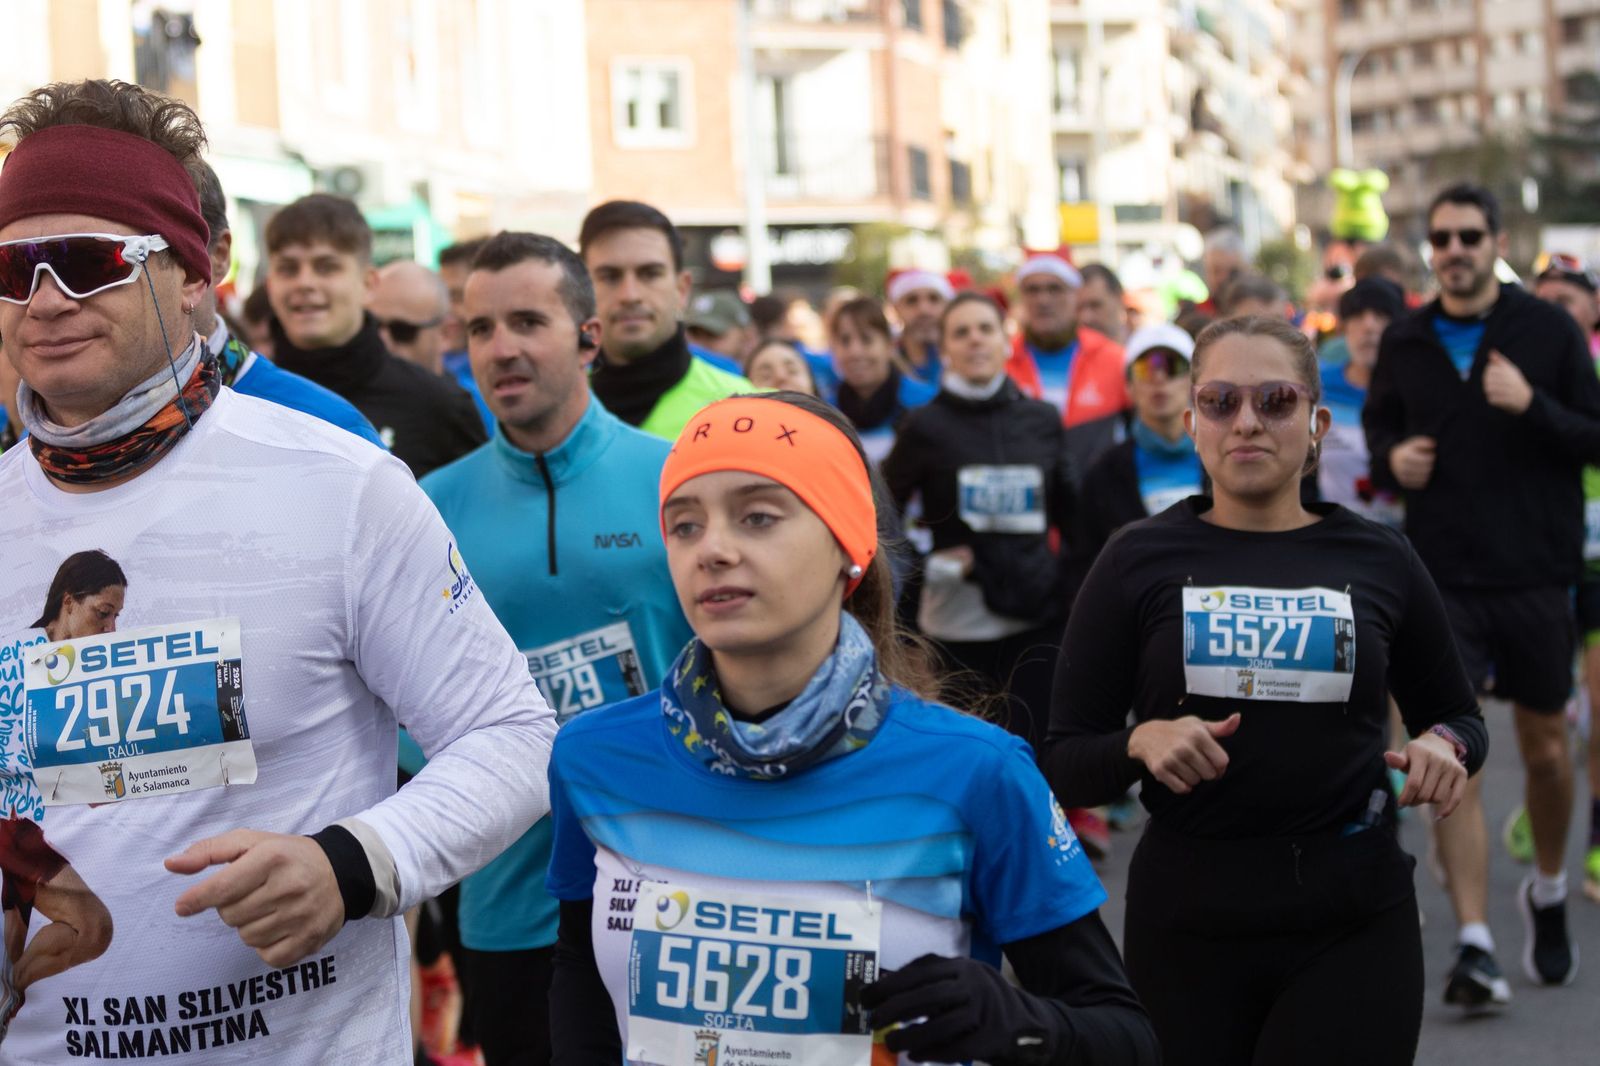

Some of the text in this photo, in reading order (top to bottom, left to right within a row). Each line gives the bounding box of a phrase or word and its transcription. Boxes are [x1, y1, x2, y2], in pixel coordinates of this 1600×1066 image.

[594, 533, 642, 548] NASA
[1230, 594, 1336, 612] SETEL
[81, 630, 219, 673] SETEL
[1209, 613, 1313, 661] 5527
[529, 636, 617, 674] SETEL
[1247, 658, 1274, 670] JOHA
[233, 667, 241, 690] 2924
[55, 669, 191, 752] 2924
[107, 741, 144, 759] RAÚL
[128, 764, 188, 781] Ayuntamiento
[131, 777, 190, 794] de Salamanca
[694, 901, 852, 941] SETEL
[62, 955, 337, 1026] XL SAN SILVESTRE
[656, 935, 812, 1020] 5628
[65, 1009, 270, 1060] SALMANTINA
[724, 1044, 793, 1060] Ayuntamiento
